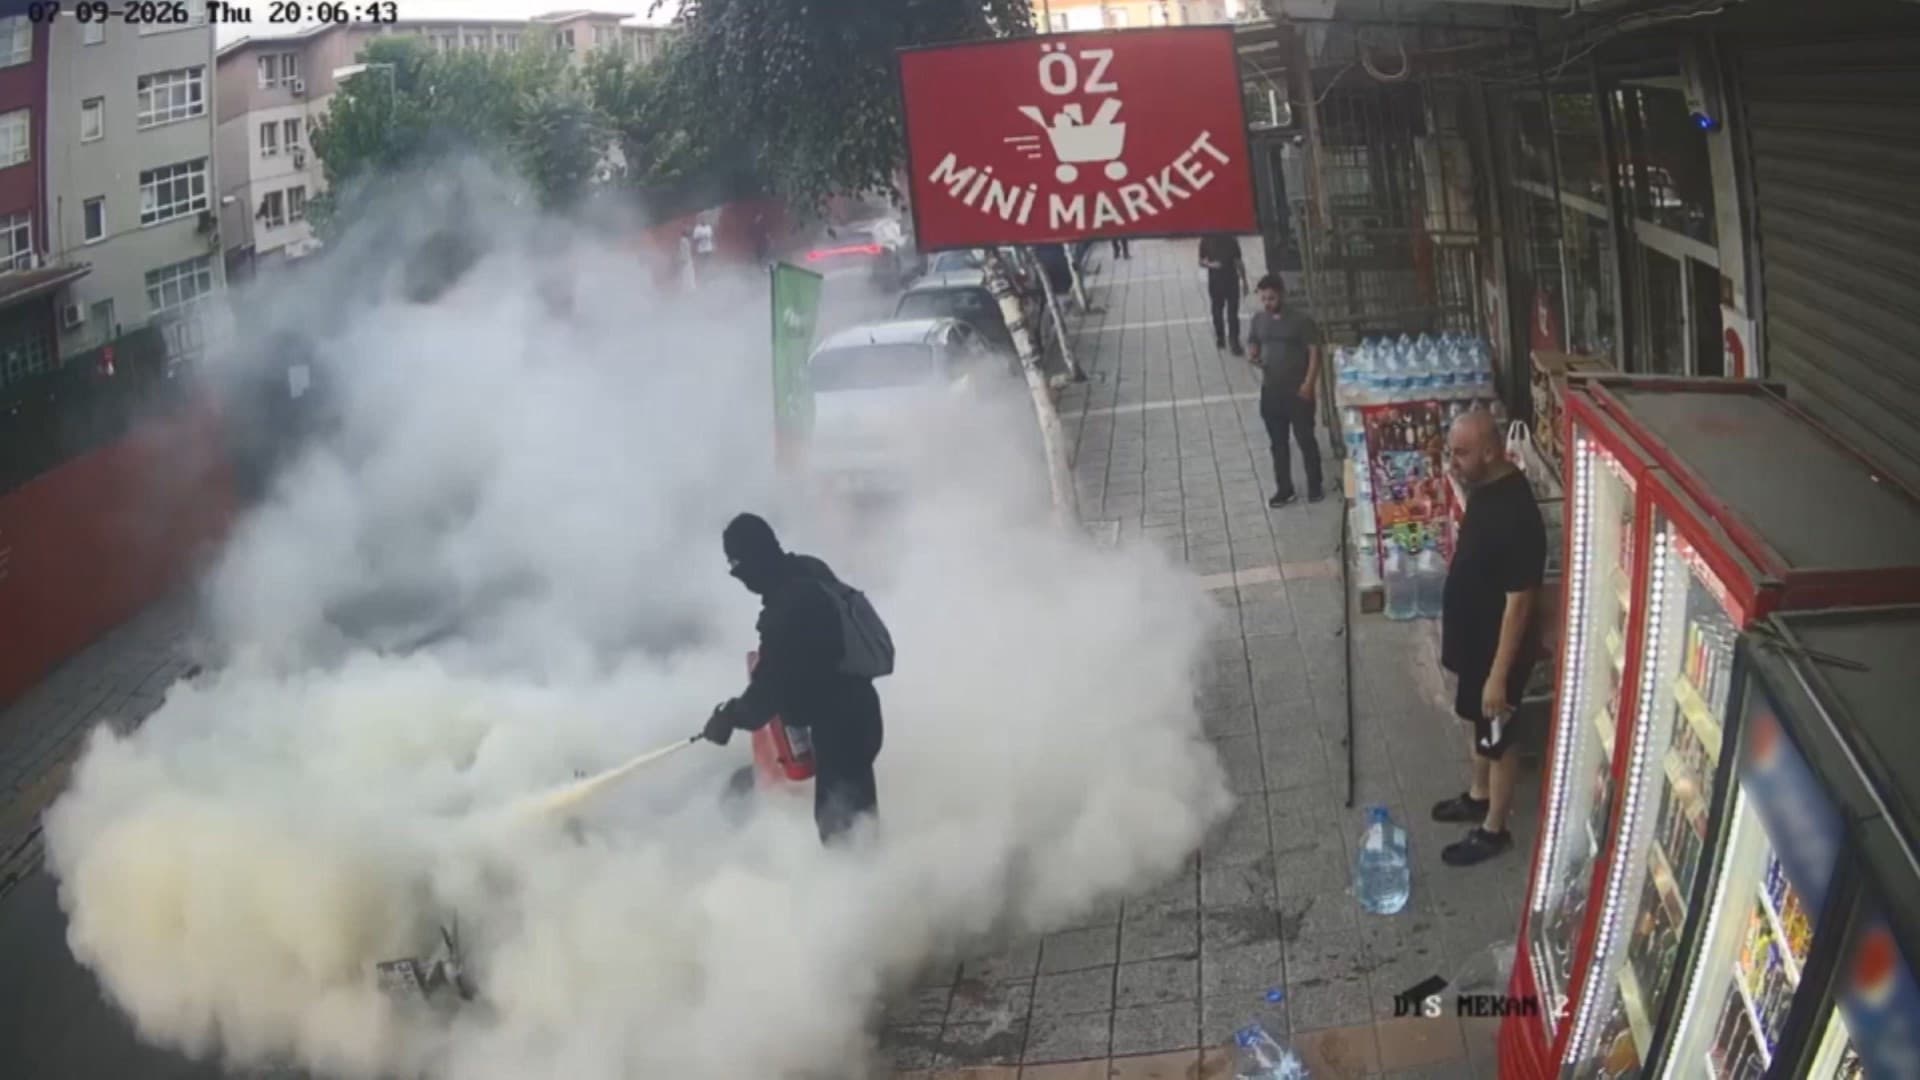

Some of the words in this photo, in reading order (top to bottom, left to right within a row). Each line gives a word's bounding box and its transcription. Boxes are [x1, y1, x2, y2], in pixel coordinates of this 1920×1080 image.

[1038, 42, 1118, 95] ÖZ
[928, 152, 1037, 226] MİNİ
[1049, 130, 1230, 230] MARKET
